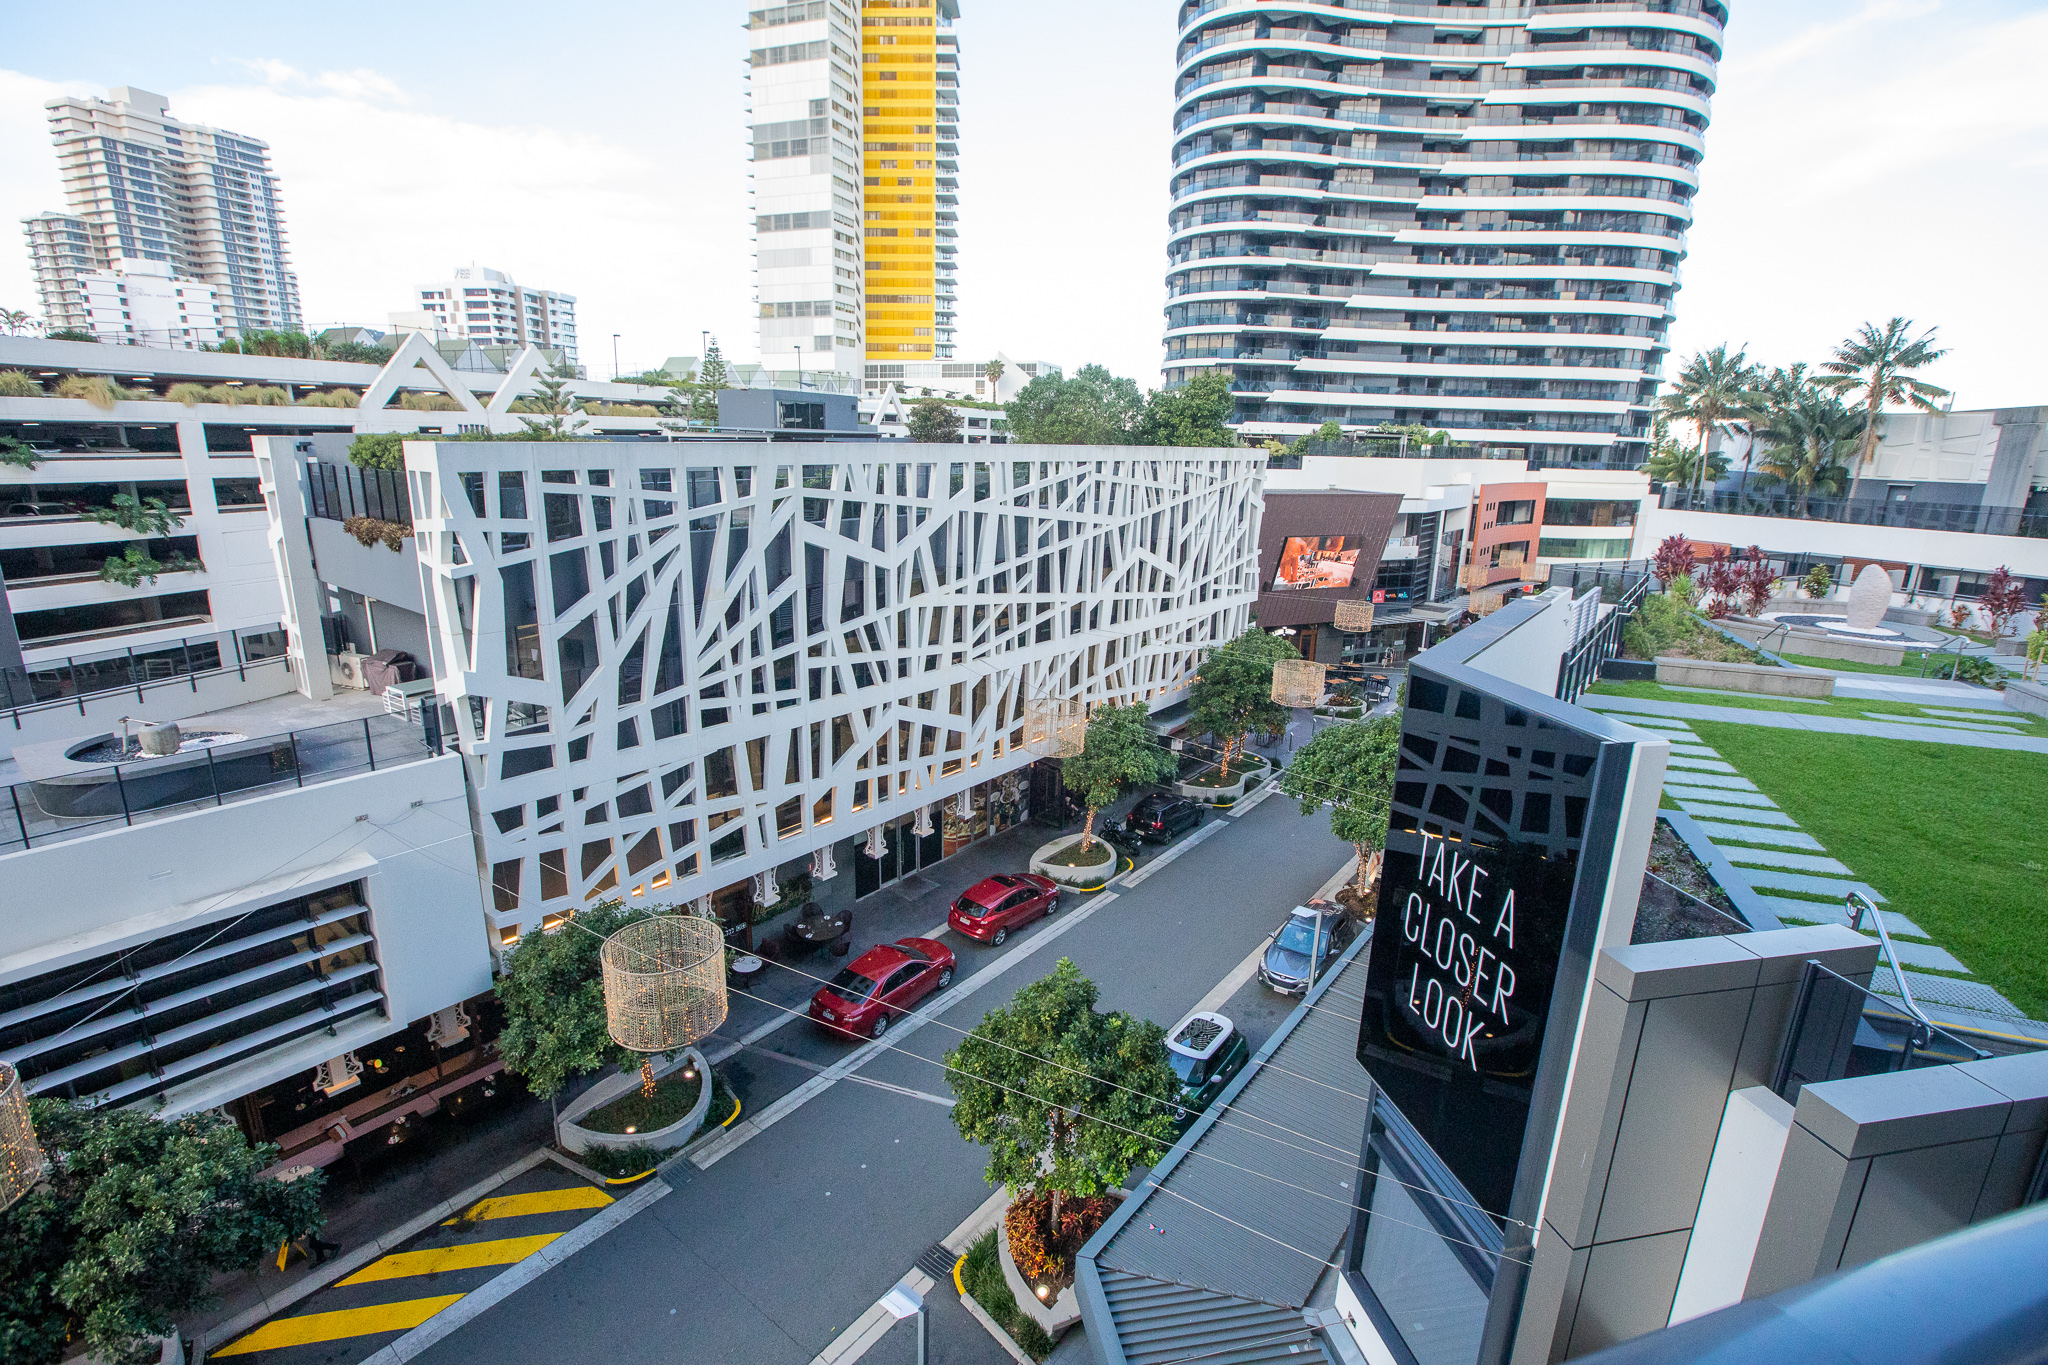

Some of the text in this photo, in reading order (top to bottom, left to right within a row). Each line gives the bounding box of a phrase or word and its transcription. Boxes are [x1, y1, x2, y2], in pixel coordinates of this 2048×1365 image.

[1419, 828, 1515, 950] TAKE A
[1404, 892, 1516, 1026] CLOSER
[1408, 962, 1486, 1072] LOOK
